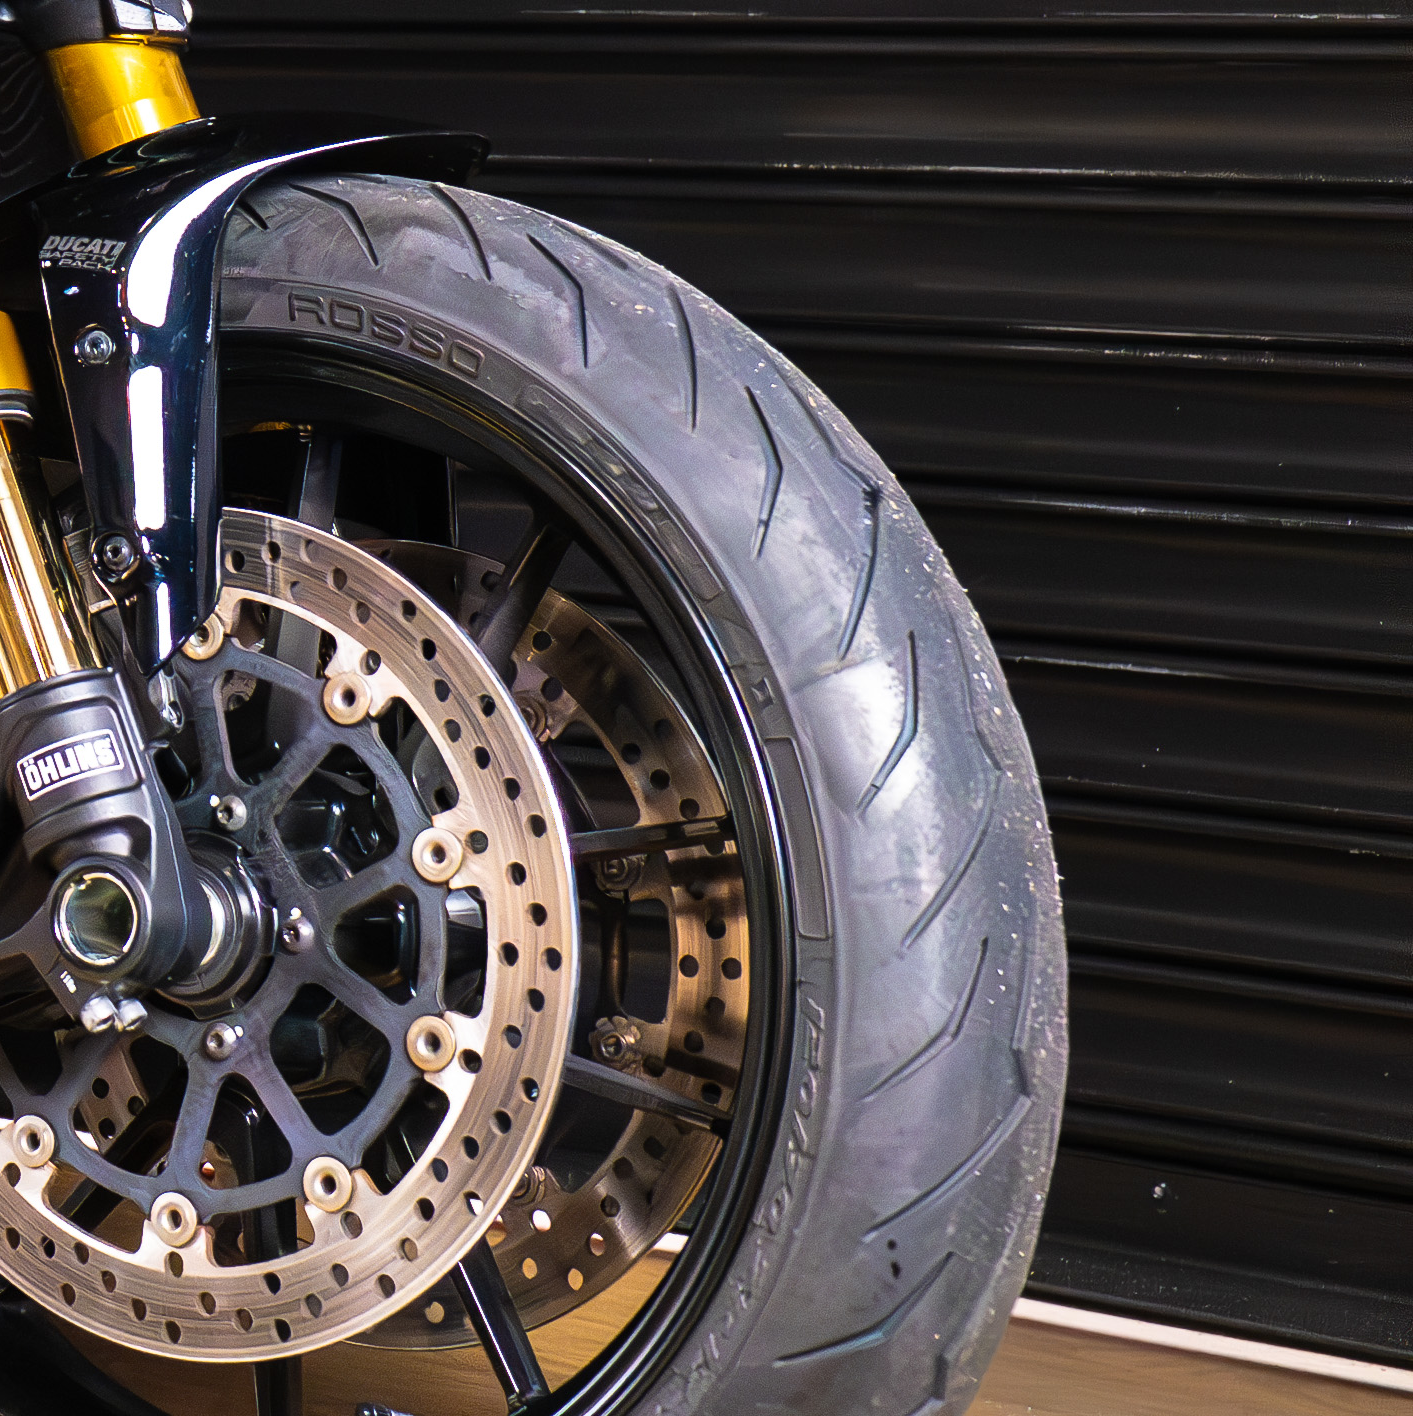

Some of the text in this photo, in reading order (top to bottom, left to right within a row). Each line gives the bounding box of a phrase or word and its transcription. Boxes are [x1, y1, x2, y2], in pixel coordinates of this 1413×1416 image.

[42, 236, 127, 256] DUCATI
[39, 250, 120, 263] SAFETY
[58, 258, 114, 272] PACK
[288, 291, 485, 380] ROSSO
[23, 737, 116, 791] ÖHLINS
